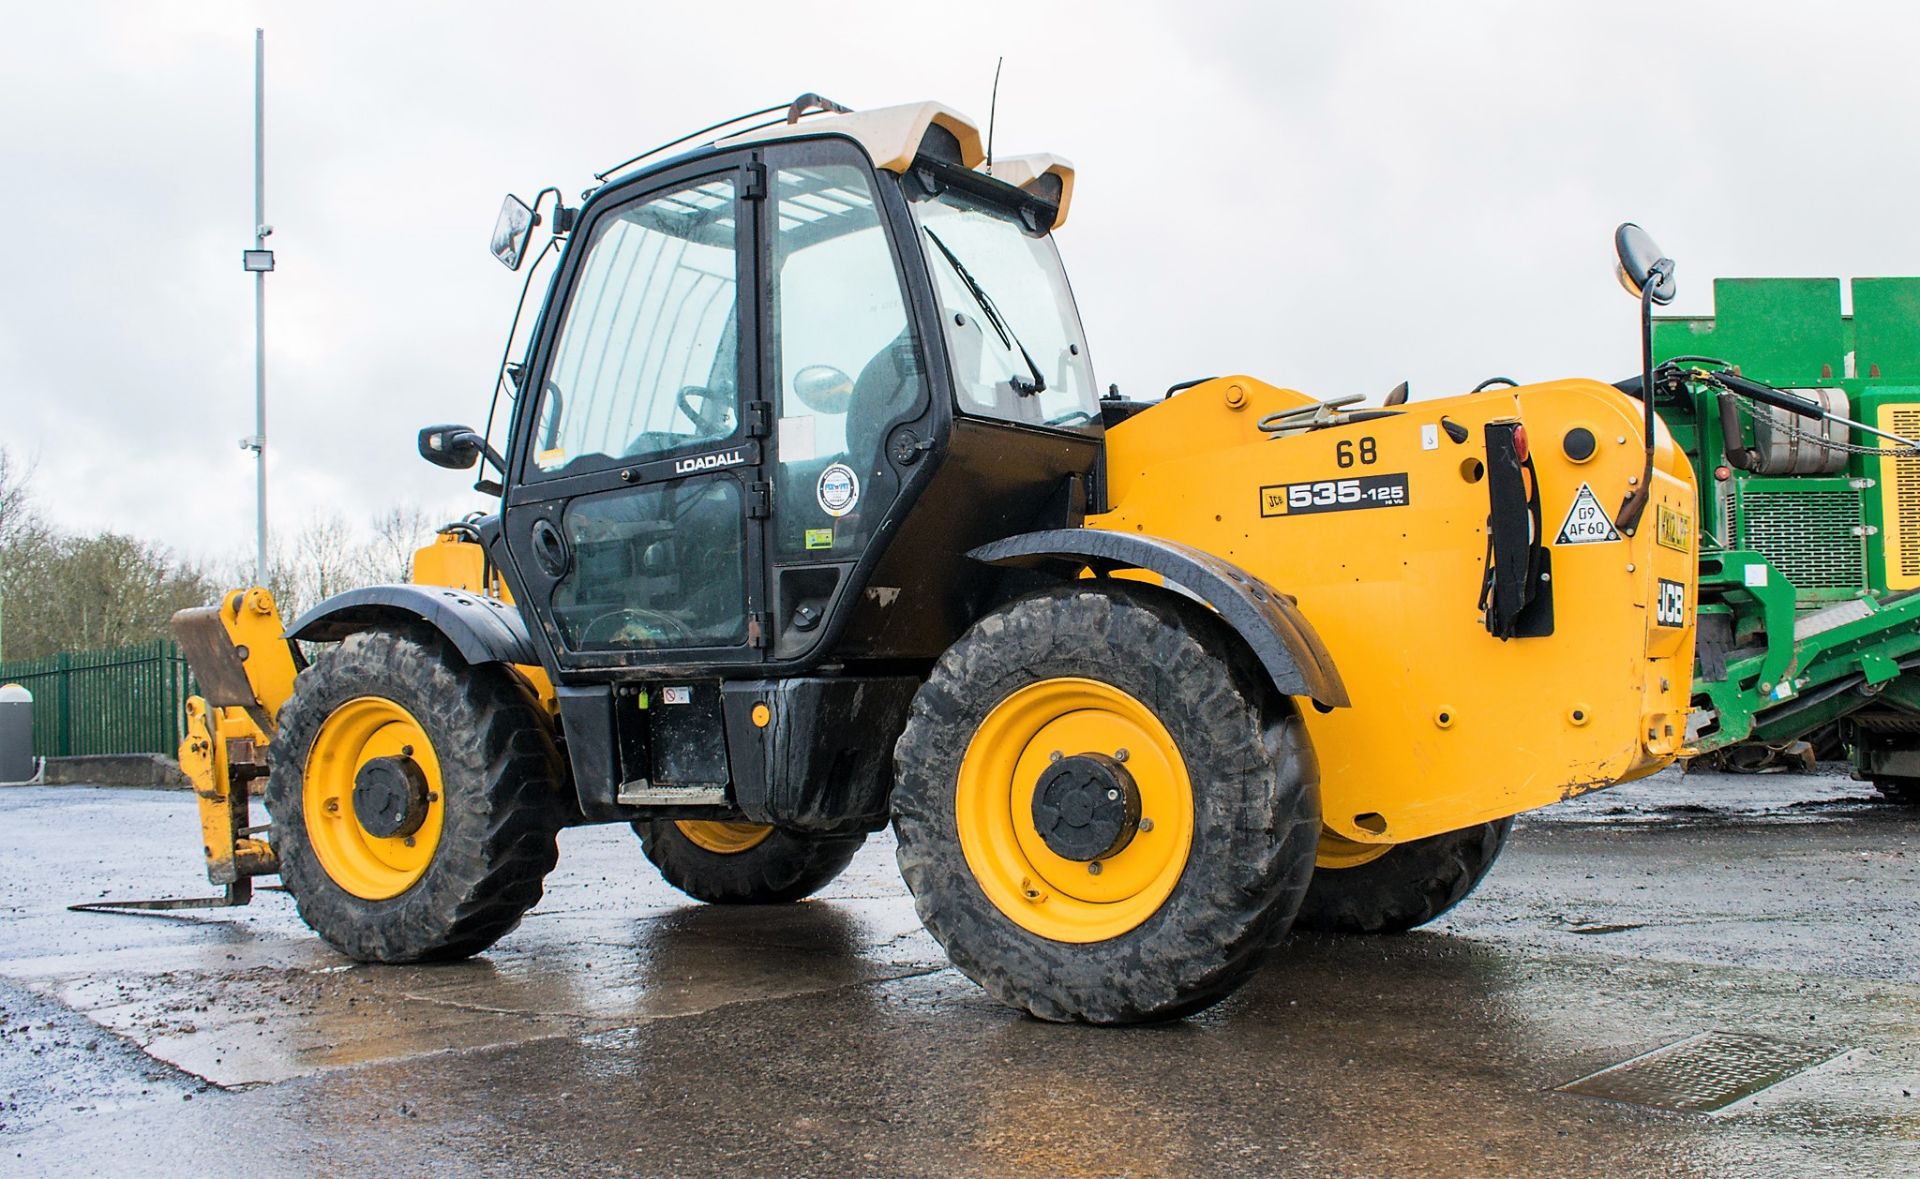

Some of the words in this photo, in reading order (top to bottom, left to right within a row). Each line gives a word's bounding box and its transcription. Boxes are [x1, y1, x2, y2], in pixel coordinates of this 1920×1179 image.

[675, 451, 745, 474] LOADALL
[1336, 436, 1377, 469] 68
[1288, 479, 1405, 508] 535-125
[1657, 582, 1684, 623] JCB
